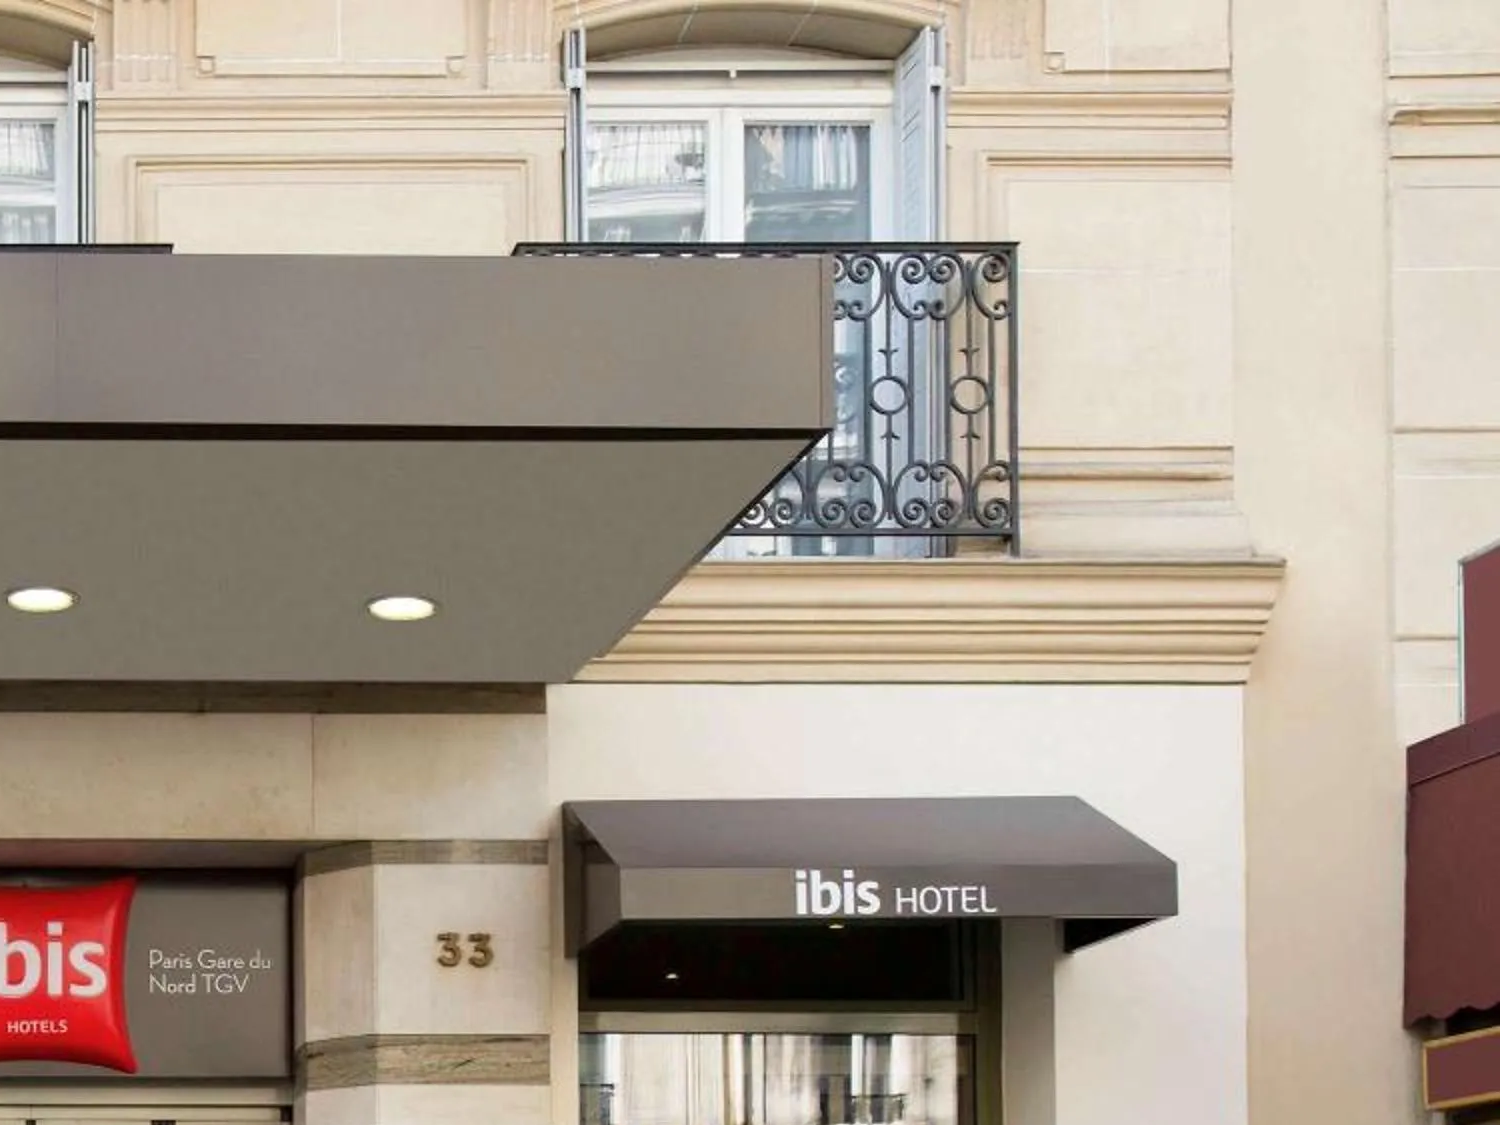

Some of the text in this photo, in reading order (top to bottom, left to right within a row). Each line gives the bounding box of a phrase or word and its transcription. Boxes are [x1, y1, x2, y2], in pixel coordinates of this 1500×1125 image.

[795, 869, 999, 916] ibis HOTEL
[149, 948, 272, 969] Paris Gare du
[437, 931, 495, 968] 33
[149, 973, 250, 994] Nord TGV
[6, 1019, 69, 1034] HOTELS
